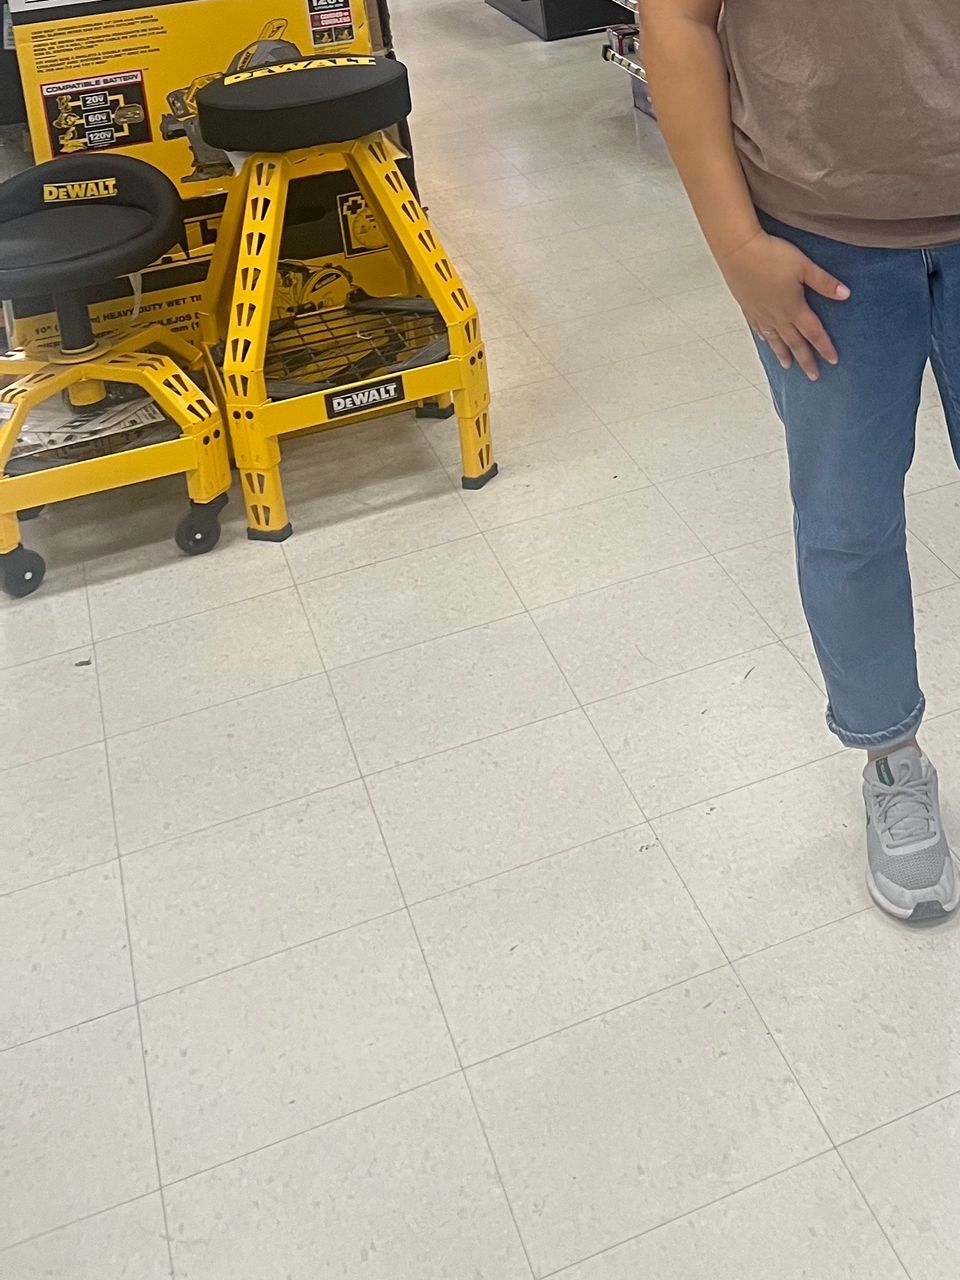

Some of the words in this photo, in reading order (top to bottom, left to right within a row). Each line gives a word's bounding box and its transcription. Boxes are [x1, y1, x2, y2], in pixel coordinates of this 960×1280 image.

[45, 80, 101, 94] COMPATIBLE
[103, 73, 139, 85] BATTERY
[103, 308, 134, 320] HEAVY
[139, 302, 163, 313] DUTY
[166, 297, 187, 307] WET
